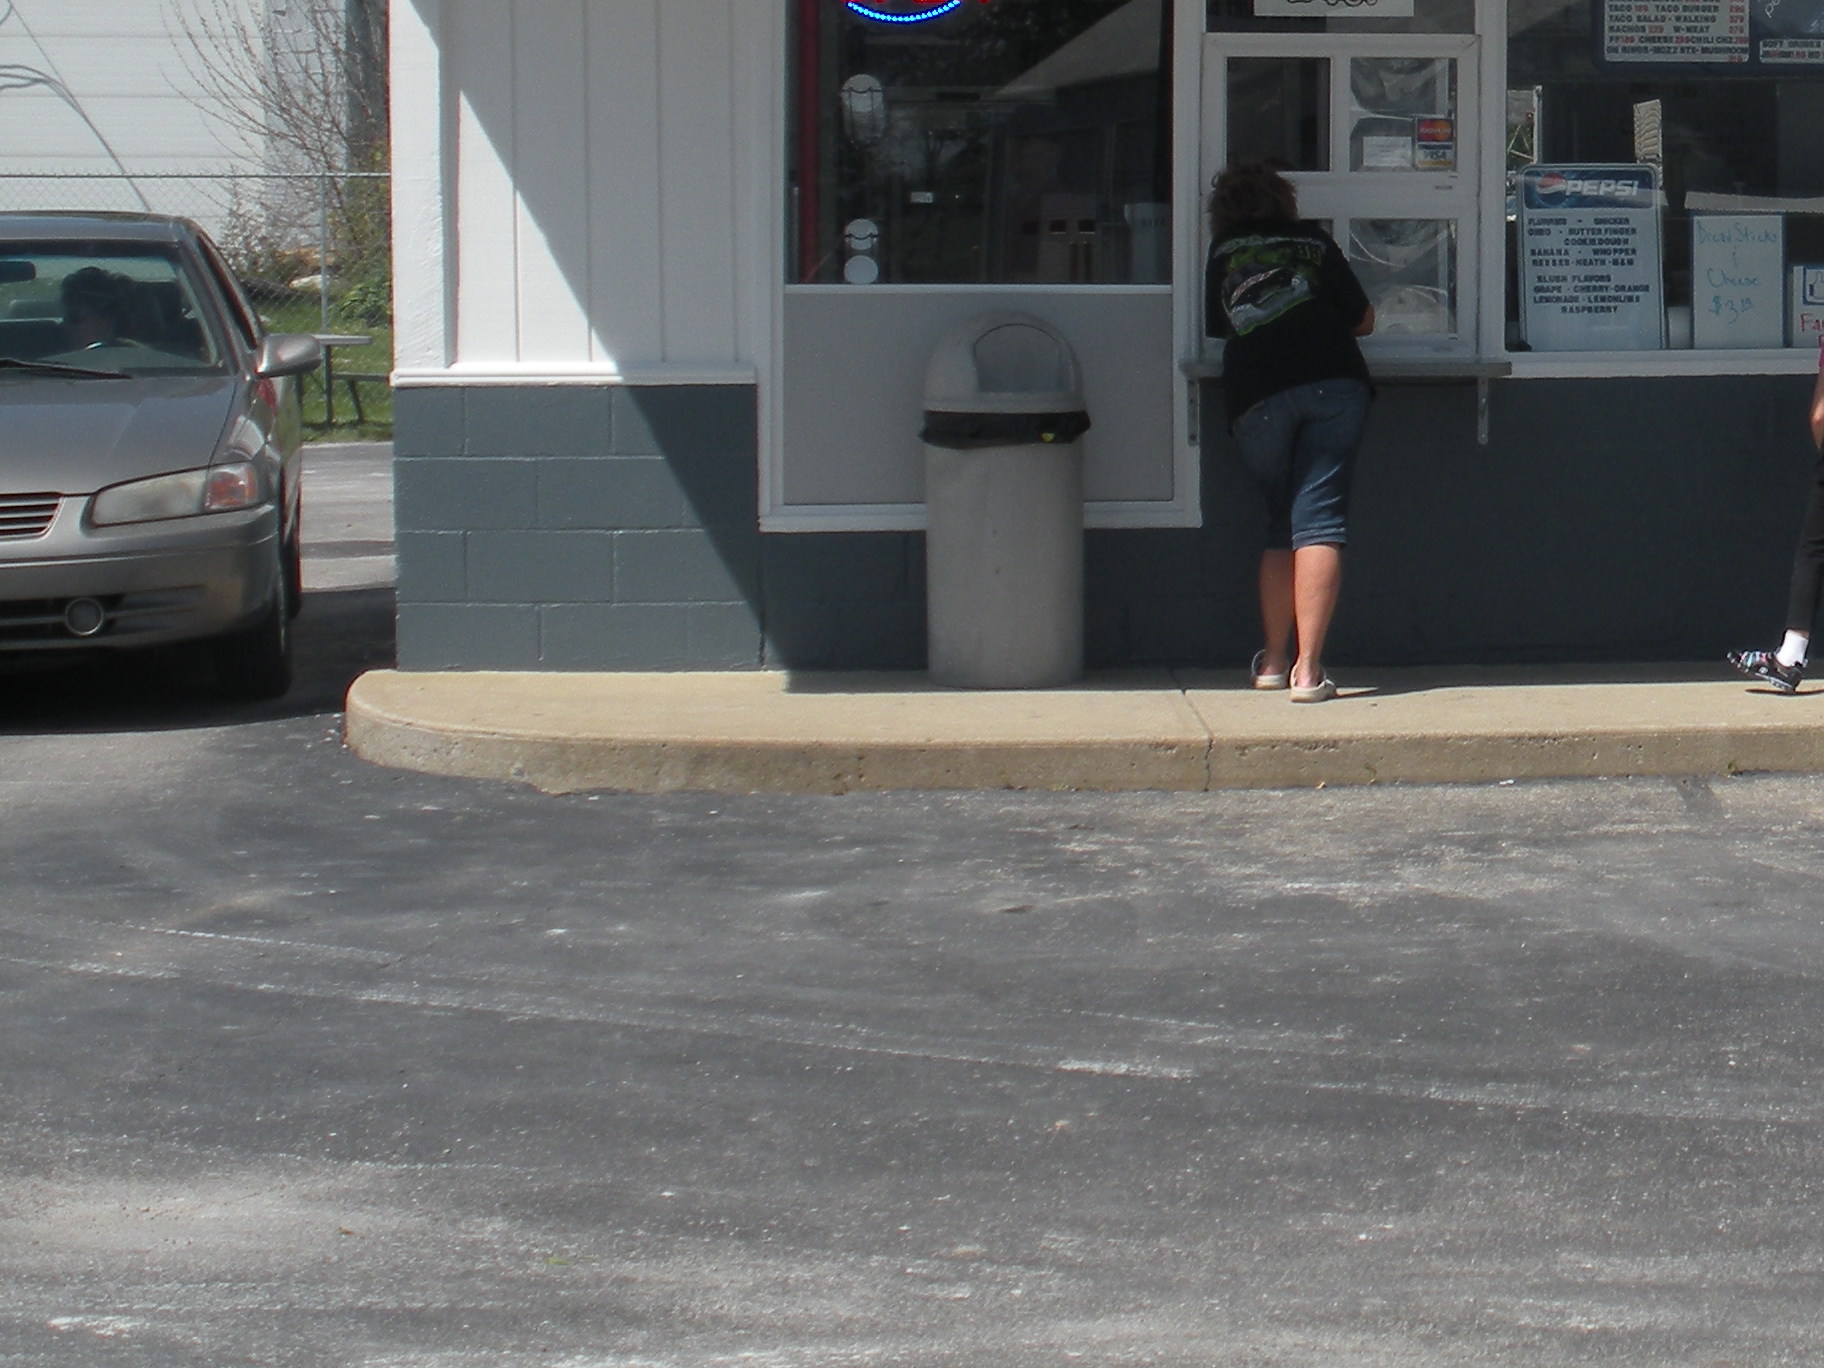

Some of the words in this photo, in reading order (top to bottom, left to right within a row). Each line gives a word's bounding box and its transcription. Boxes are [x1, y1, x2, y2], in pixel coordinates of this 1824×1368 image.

[1608, 5, 1632, 13] TACO
[1655, 5, 1680, 13] TACO
[1682, 5, 1719, 13] BURGER
[1608, 15, 1633, 23] TACO
[1636, 15, 1667, 23] SALAD
[1674, 15, 1717, 23] WALKING
[1608, 26, 1646, 34] NACHOS
[1423, 150, 1447, 160] VISA
[1565, 180, 1640, 196] PEPSI
[1530, 248, 1570, 256] BANANA
[1592, 248, 1637, 256] WHOPPER
[1537, 274, 1568, 283] SLUSH
[1572, 274, 1612, 283] FLAVORS
[1533, 285, 1562, 293] GRAPE
[1573, 285, 1609, 293] CHERRY
[1613, 285, 1650, 293] ORANGE
[1533, 295, 1580, 304] LEMONADE
[1561, 305, 1618, 314] RASPBERRY
